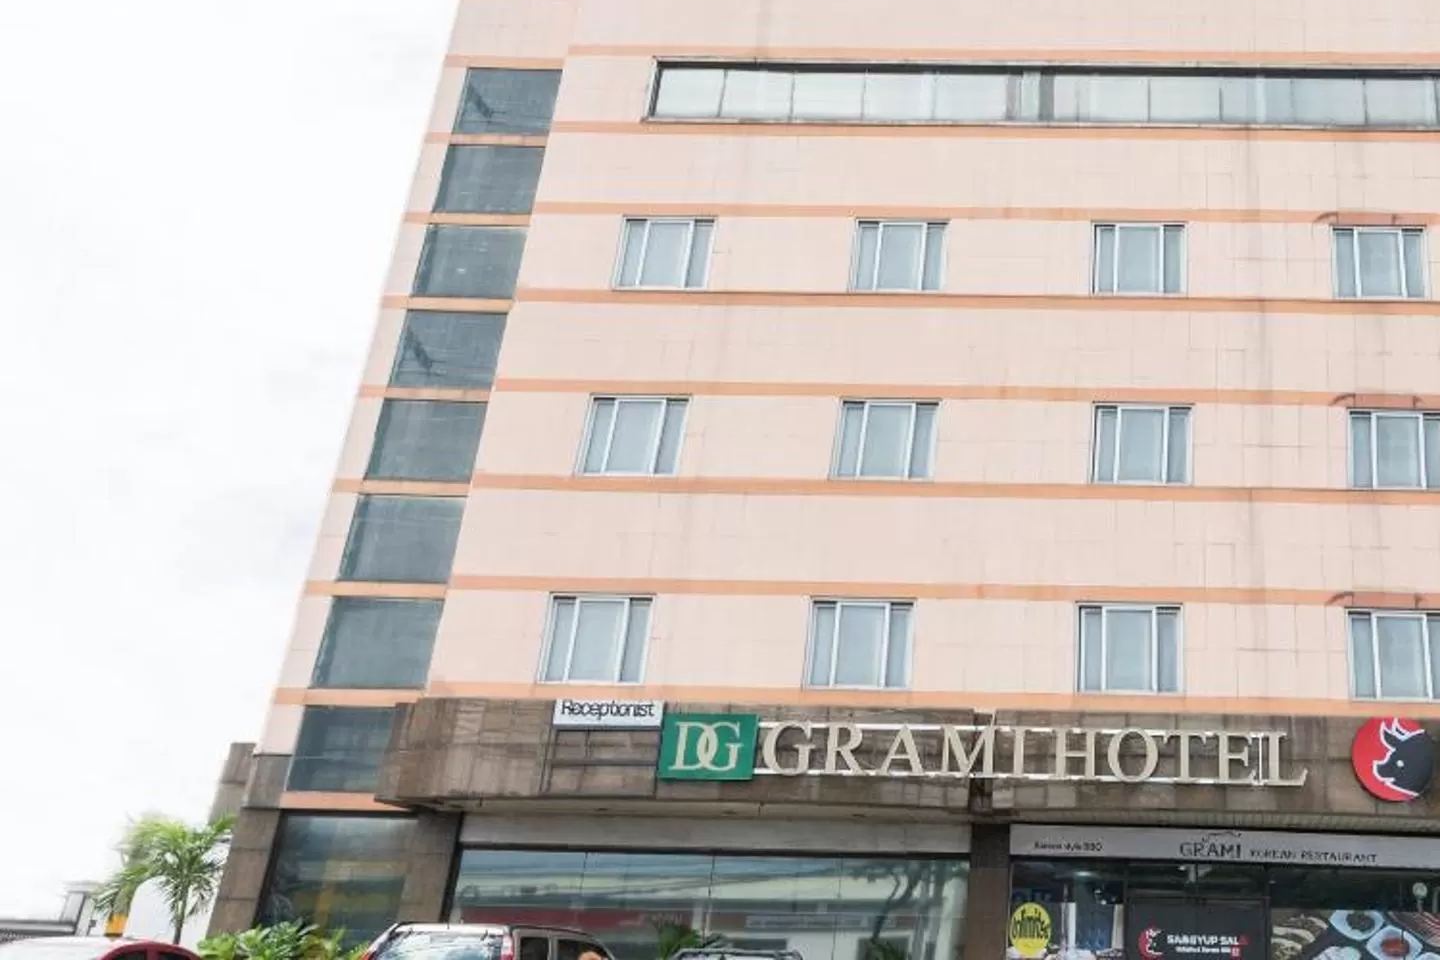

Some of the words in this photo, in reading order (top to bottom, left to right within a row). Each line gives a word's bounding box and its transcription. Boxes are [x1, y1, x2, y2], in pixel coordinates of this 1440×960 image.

[561, 700, 655, 720] Receptionist
[668, 721, 741, 772] DG
[761, 719, 1030, 778] GRAMI
[1053, 724, 1307, 786] HOTEL
[1179, 842, 1242, 859] GRAMI
